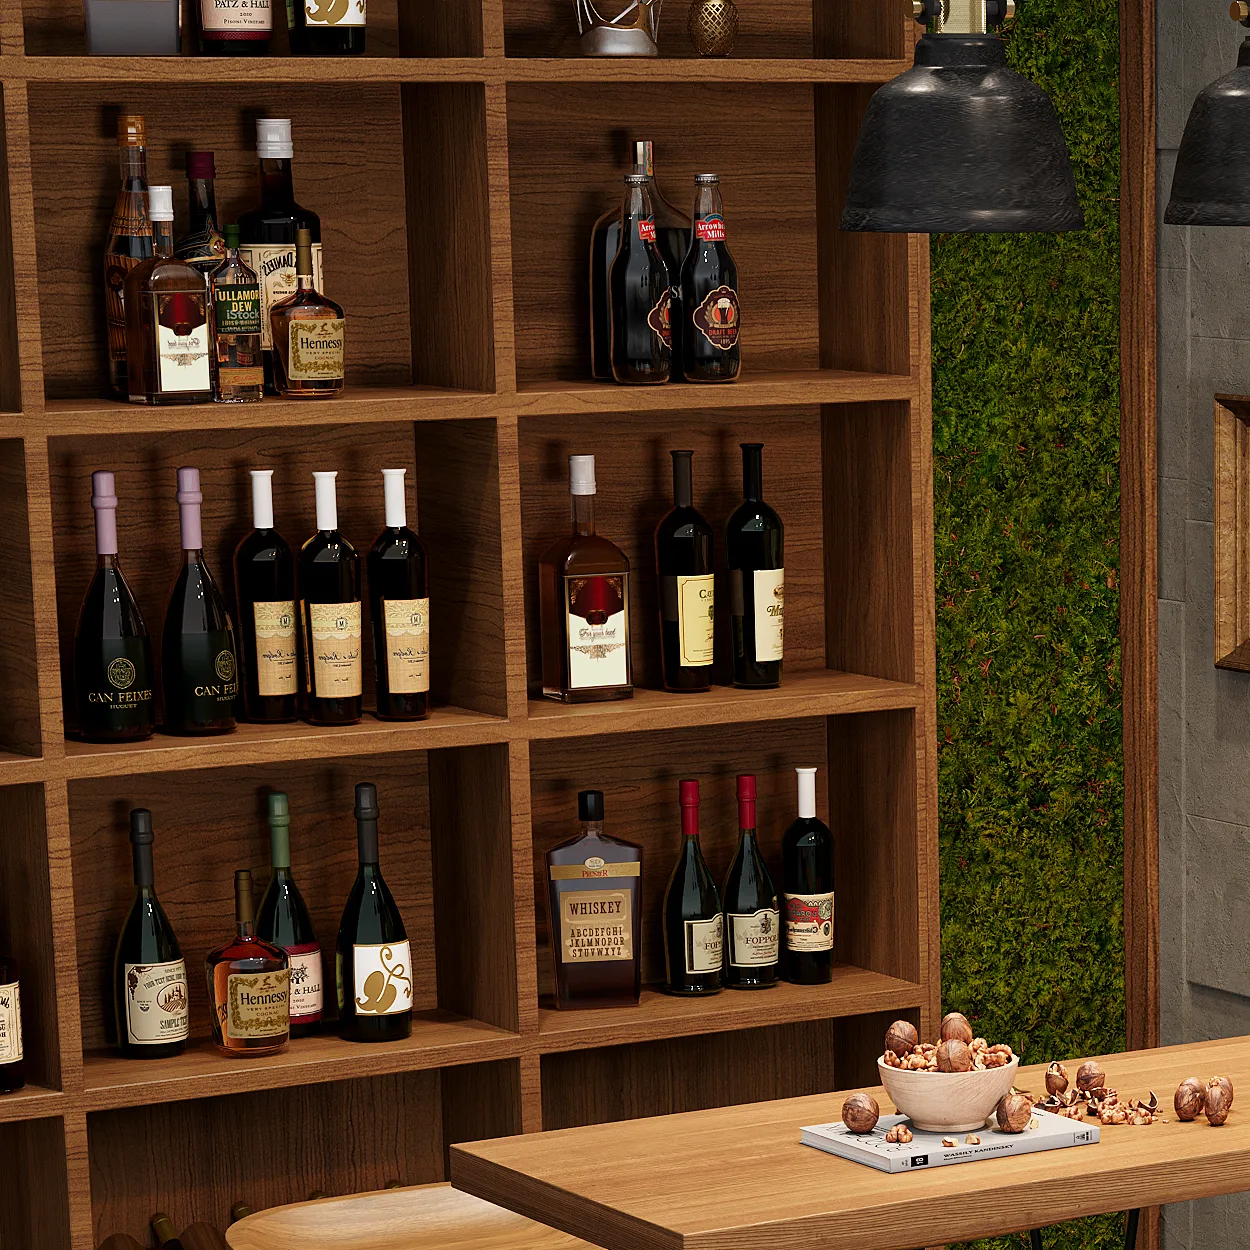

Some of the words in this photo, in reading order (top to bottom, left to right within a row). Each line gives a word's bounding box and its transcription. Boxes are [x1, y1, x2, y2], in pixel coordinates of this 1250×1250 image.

[215, 0, 240, 9] PATZ
[241, 0, 249, 8] &
[251, 0, 270, 9] HALL
[707, 230, 725, 239] Mills
[232, 302, 252, 312] DEW
[227, 309, 260, 320] iStock
[89, 692, 113, 703] CAN
[117, 689, 152, 703] FEIXES
[195, 685, 221, 697] CAN
[570, 901, 622, 915] WHISKEY
[294, 988, 301, 996] &
[303, 984, 322, 995] HALL
